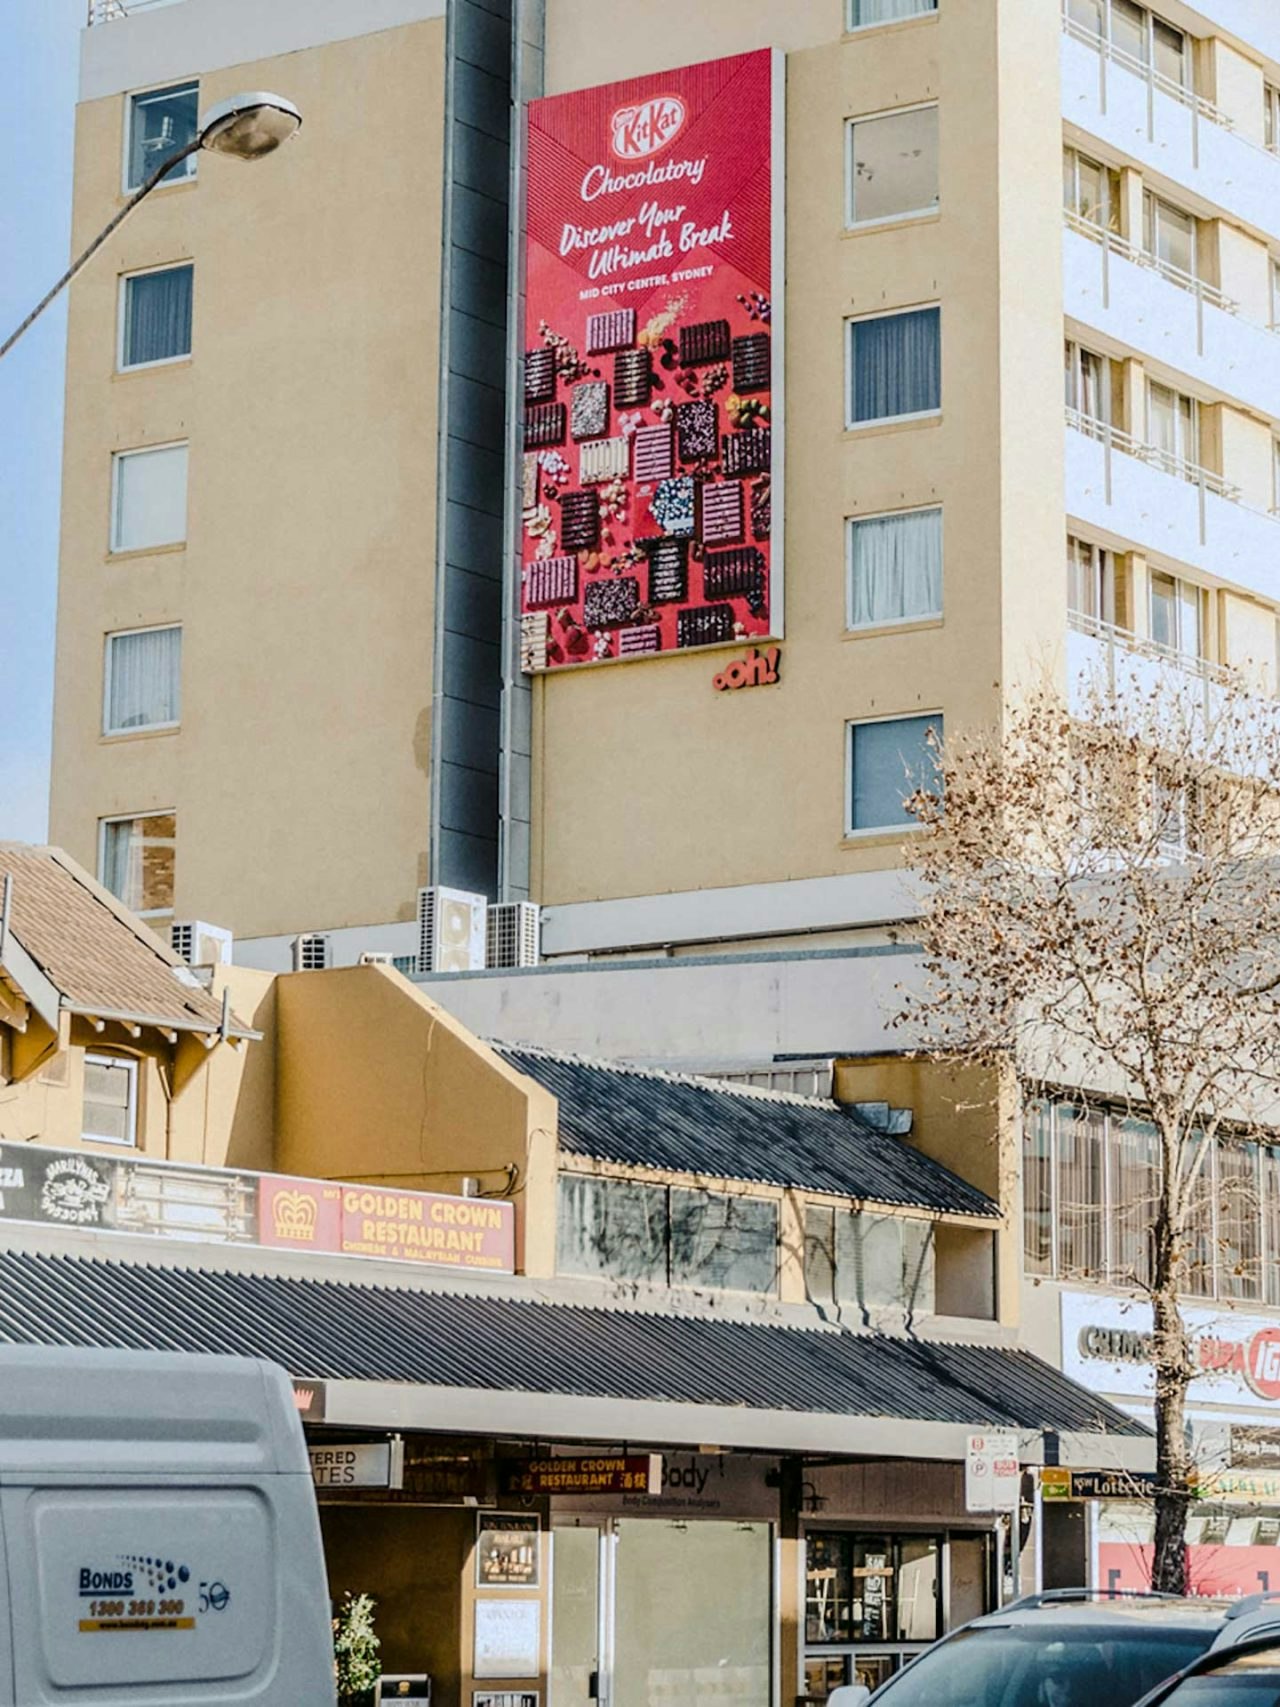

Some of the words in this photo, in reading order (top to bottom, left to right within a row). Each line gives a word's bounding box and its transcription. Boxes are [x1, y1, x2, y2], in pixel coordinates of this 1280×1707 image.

[624, 102, 678, 153] KitKat
[581, 157, 707, 202] Chocolatory
[559, 216, 636, 256] Discover
[638, 201, 686, 237] Your
[588, 230, 674, 280] Ultimate
[679, 210, 734, 252] Break
[579, 288, 600, 301] MID
[601, 282, 626, 297] CITY
[627, 275, 670, 291] CENTRE,
[672, 265, 714, 283] SYDNEY
[344, 1192, 424, 1221] GOLDEN
[431, 1202, 502, 1229] CROWN
[362, 1220, 484, 1253] RESTAURANT
[529, 1459, 577, 1474] GOLDEN
[580, 1459, 625, 1472] CROWN
[539, 1473, 614, 1488] RESTAURANT
[1094, 1478, 1156, 1495] Lotterie
[79, 1567, 134, 1589] BONDS
